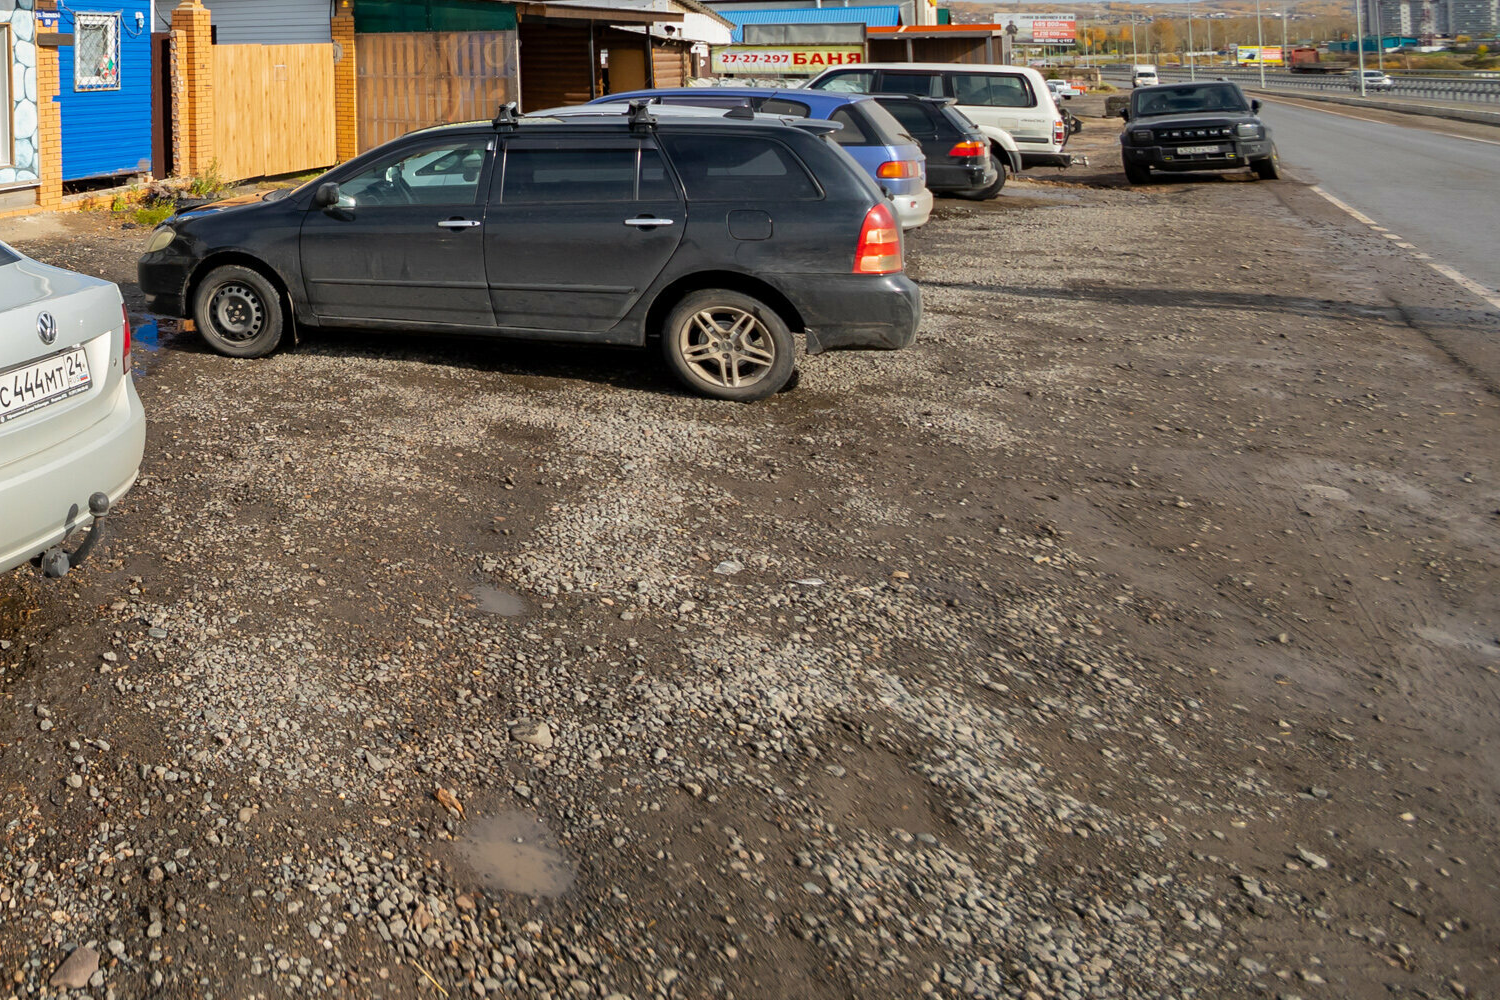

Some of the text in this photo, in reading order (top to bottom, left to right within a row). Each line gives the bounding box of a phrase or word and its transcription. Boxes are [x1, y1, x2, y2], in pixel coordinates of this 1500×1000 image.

[722, 52, 861, 65] 27-27-297 БАНЯ
[1160, 128, 1231, 137] JETOUR
[67, 353, 83, 376] 24
